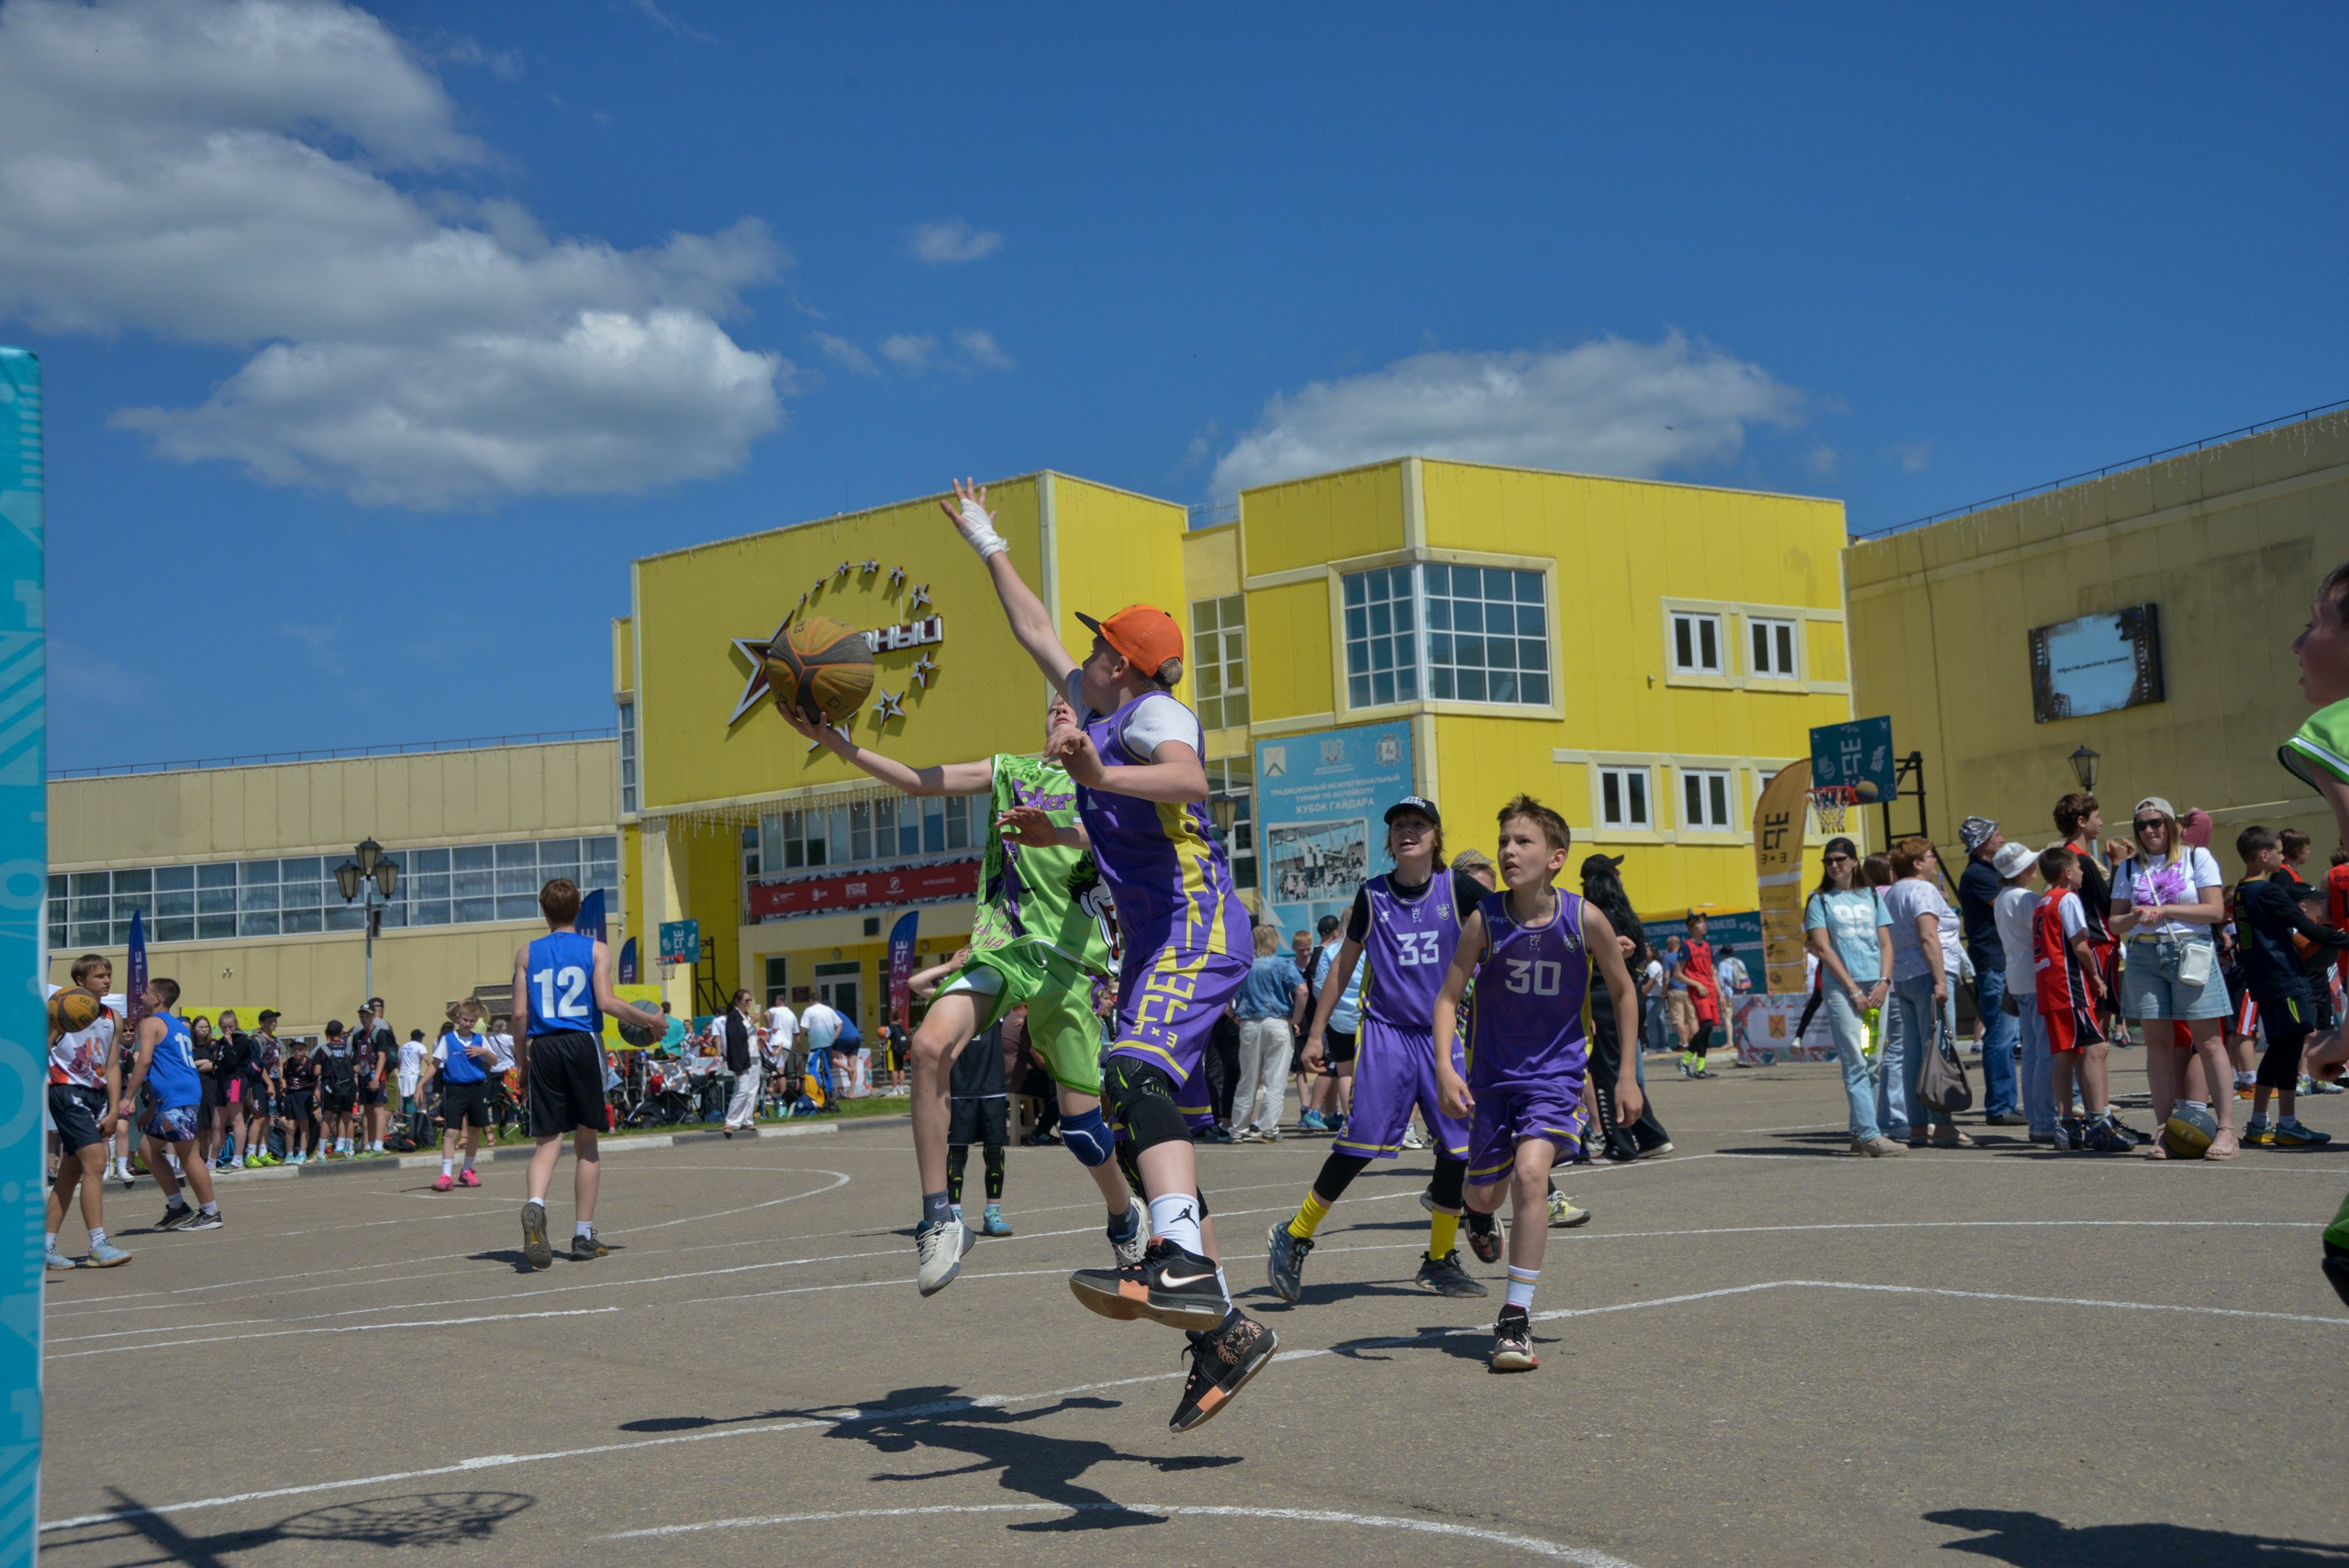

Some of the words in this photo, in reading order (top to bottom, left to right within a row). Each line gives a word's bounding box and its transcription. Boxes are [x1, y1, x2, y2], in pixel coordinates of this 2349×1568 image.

[1270, 783, 1327, 796] ТРАДИЦИОННЫЙ
[1328, 773, 1401, 790] МЕЖРЕГИОНАЛЬНЫЙ
[1296, 794, 1321, 803] ТУРНИР
[1333, 787, 1375, 798] ВОЛЕЙБОЛУ
[1296, 803, 1328, 814] КУБОК
[1330, 797, 1375, 810] ГАЙДАРА
[1396, 929, 1440, 967] 33
[533, 965, 589, 1018] 12
[1505, 958, 1562, 996] 30
